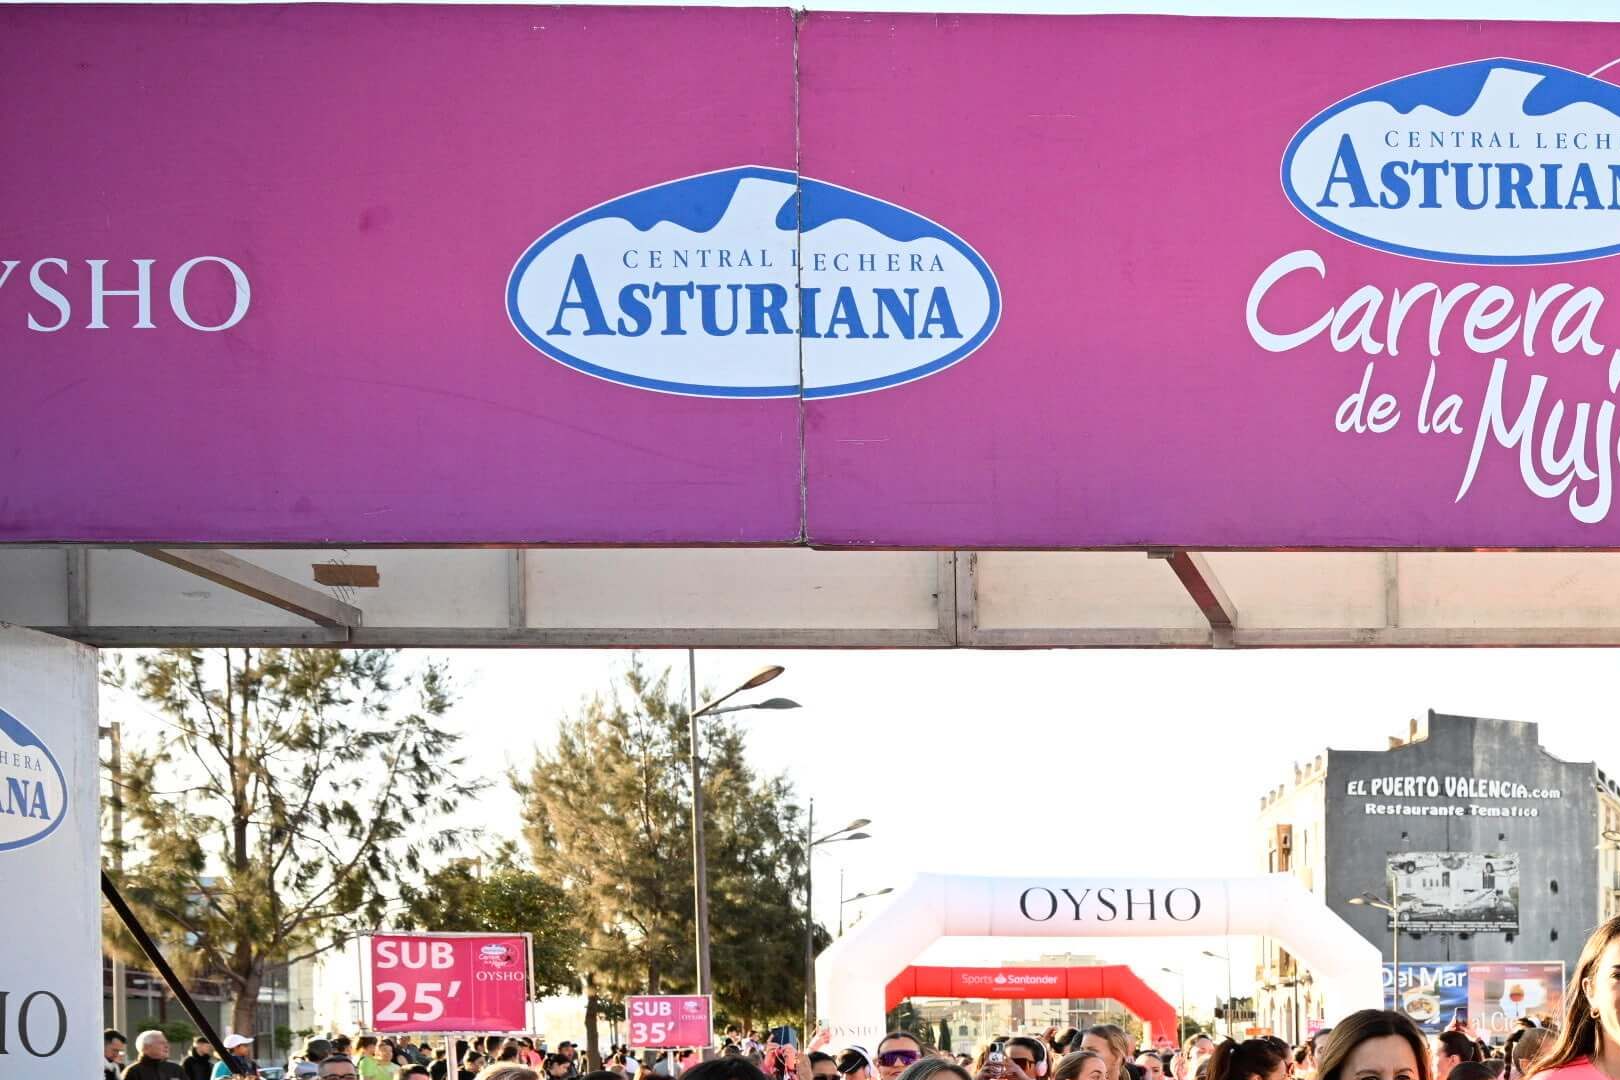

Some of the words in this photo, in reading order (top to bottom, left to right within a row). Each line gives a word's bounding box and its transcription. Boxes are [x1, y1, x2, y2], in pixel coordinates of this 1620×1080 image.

[1384, 130, 1523, 150] CENTRAL
[622, 248, 774, 270] CENTRAL
[790, 250, 946, 273] LECHERA
[546, 253, 962, 341] ASTURIANA
[1246, 249, 1605, 357] Carrera
[1334, 361, 1401, 436] de
[1417, 364, 1465, 437] la
[1346, 780, 1367, 796] EL
[1371, 775, 1439, 798] PUERTO
[1444, 776, 1561, 799] VALENCIA.com
[1364, 803, 1465, 817] Restaurante
[1469, 804, 1539, 818] Tematico
[1018, 886, 1202, 923] OYSHO
[376, 940, 455, 969] SUB
[475, 970, 525, 982] OYSHO
[1006, 972, 1059, 985] Santander
[1420, 967, 1467, 988] Mar
[632, 1001, 672, 1017] SUB
